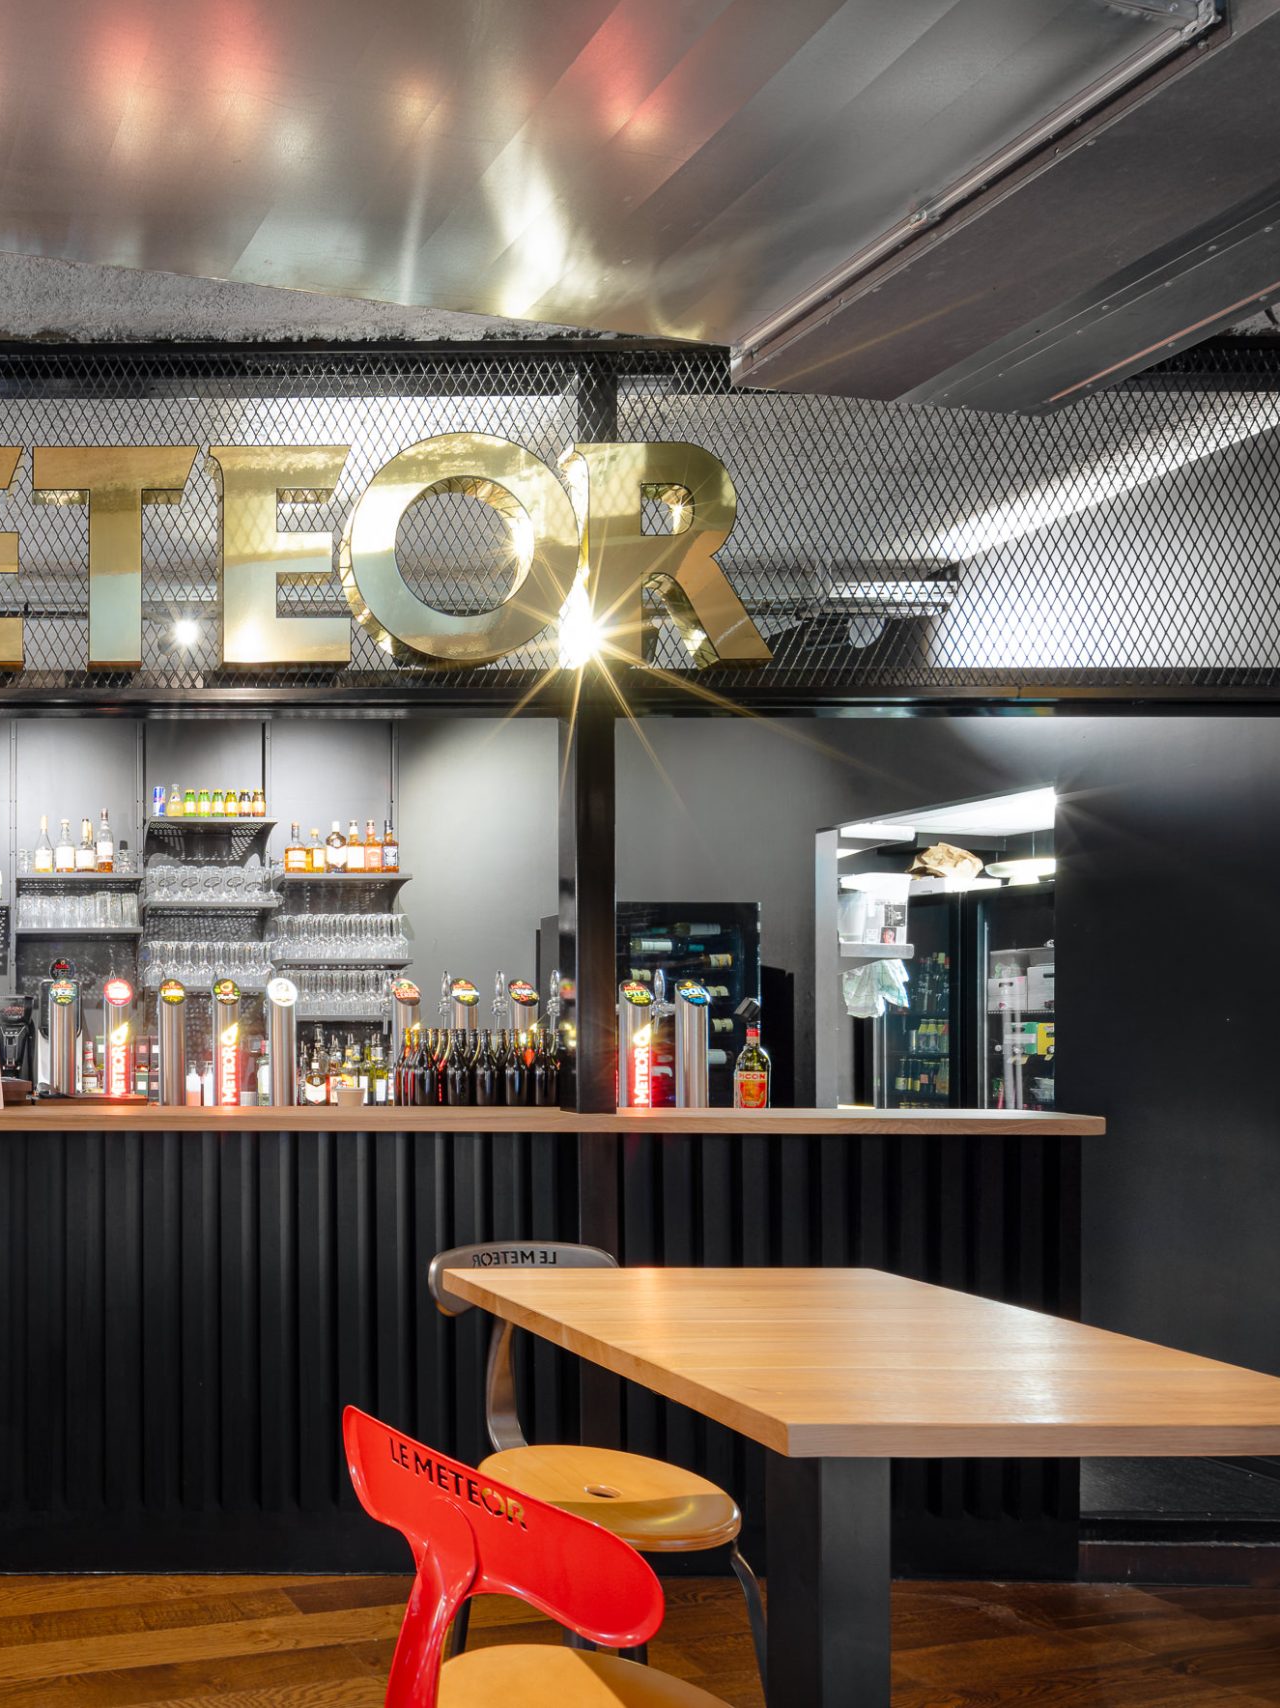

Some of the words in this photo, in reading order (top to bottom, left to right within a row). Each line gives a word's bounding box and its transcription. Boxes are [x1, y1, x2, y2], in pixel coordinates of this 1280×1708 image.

[222, 1045, 237, 1102] METEOR
[634, 1047, 649, 1104] METEOR
[389, 1437, 408, 1468] LE
[415, 1451, 528, 1531] METEOR
